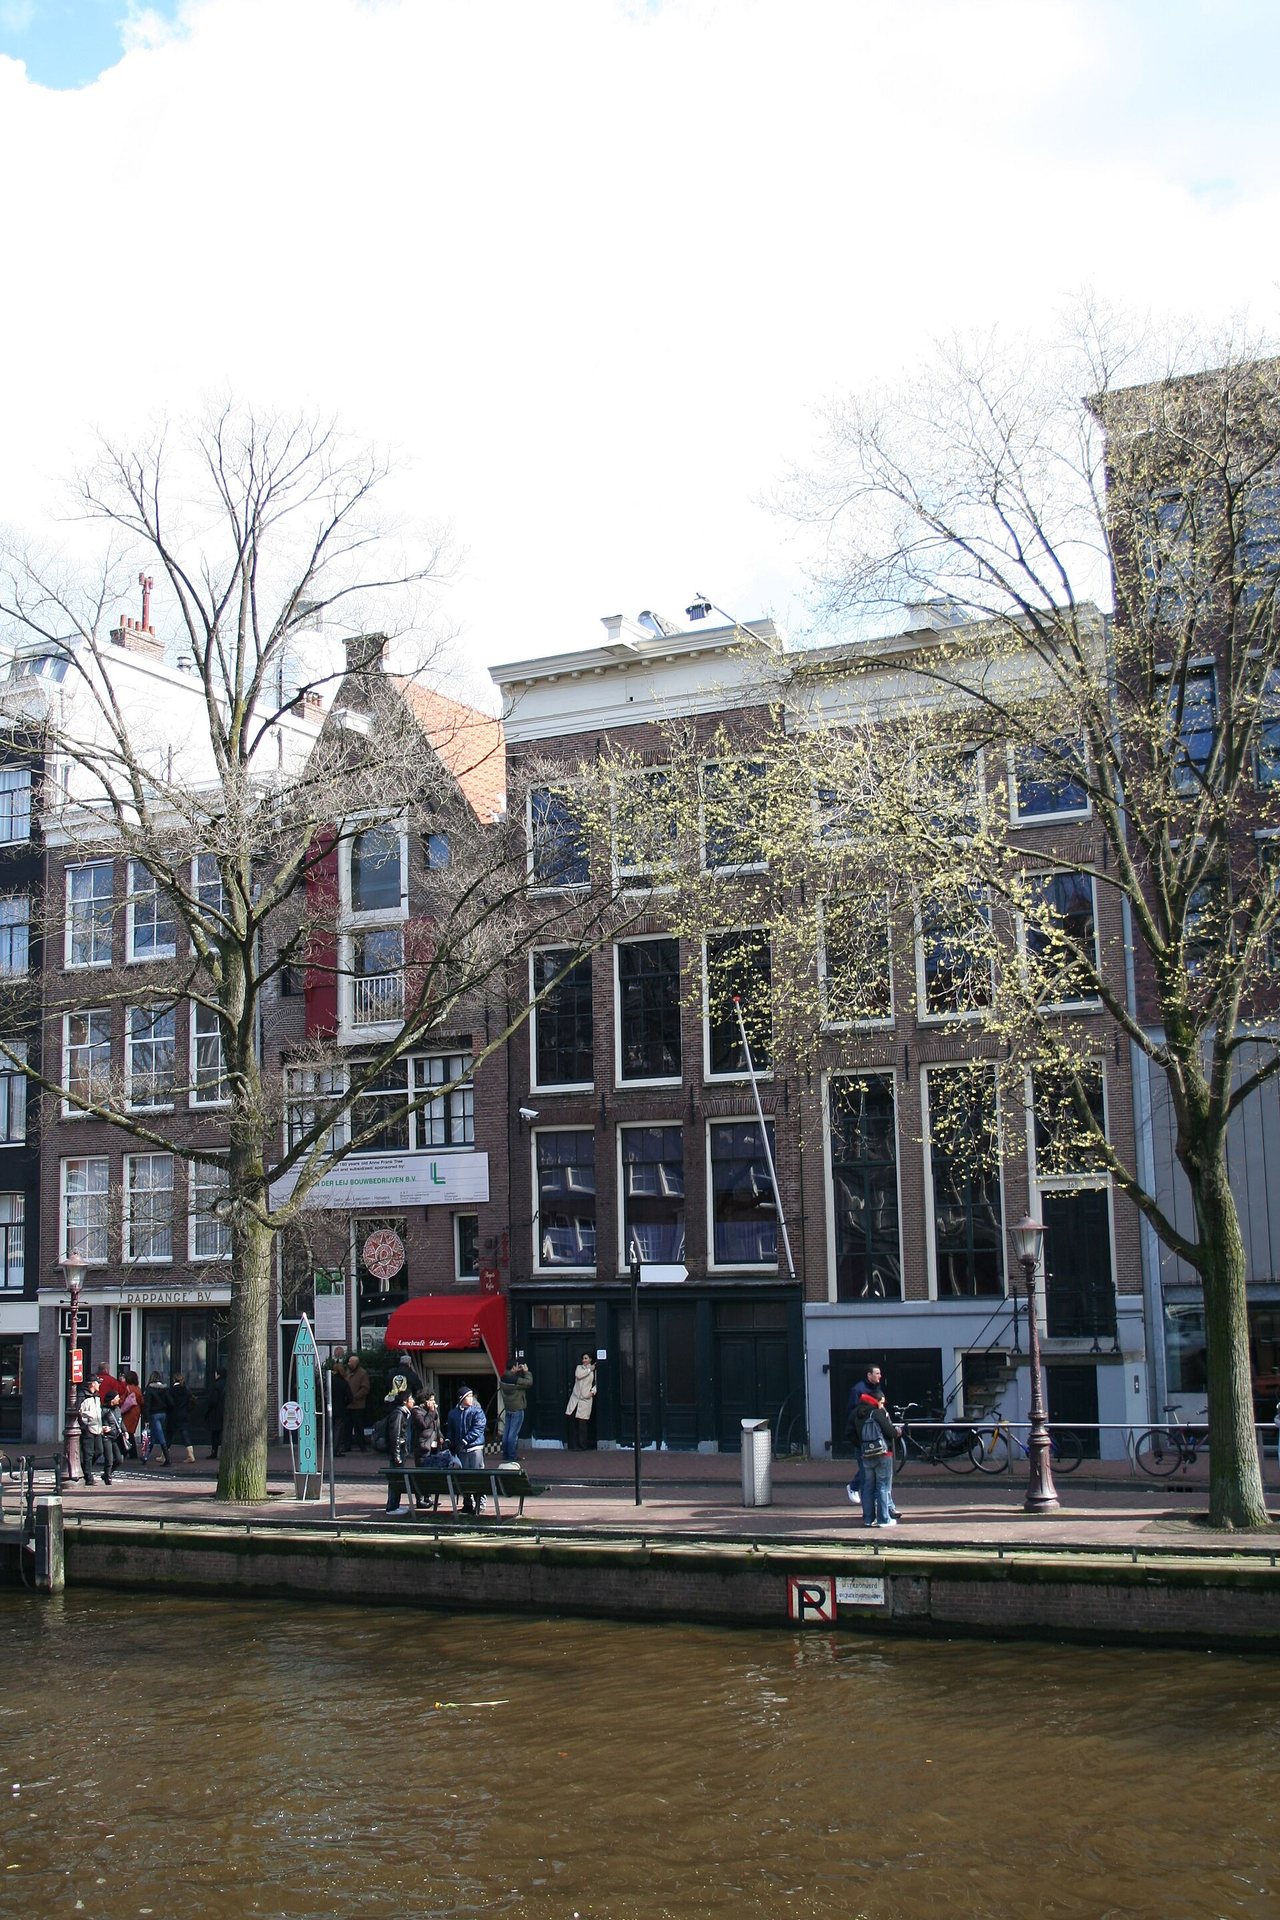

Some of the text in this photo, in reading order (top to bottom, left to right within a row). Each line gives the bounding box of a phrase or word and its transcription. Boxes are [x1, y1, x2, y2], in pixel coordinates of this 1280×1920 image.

[350, 1177, 403, 1186] BOUWBEDRIJVEN
[301, 1327, 308, 1340] 7
[298, 1344, 314, 1353] STOP
